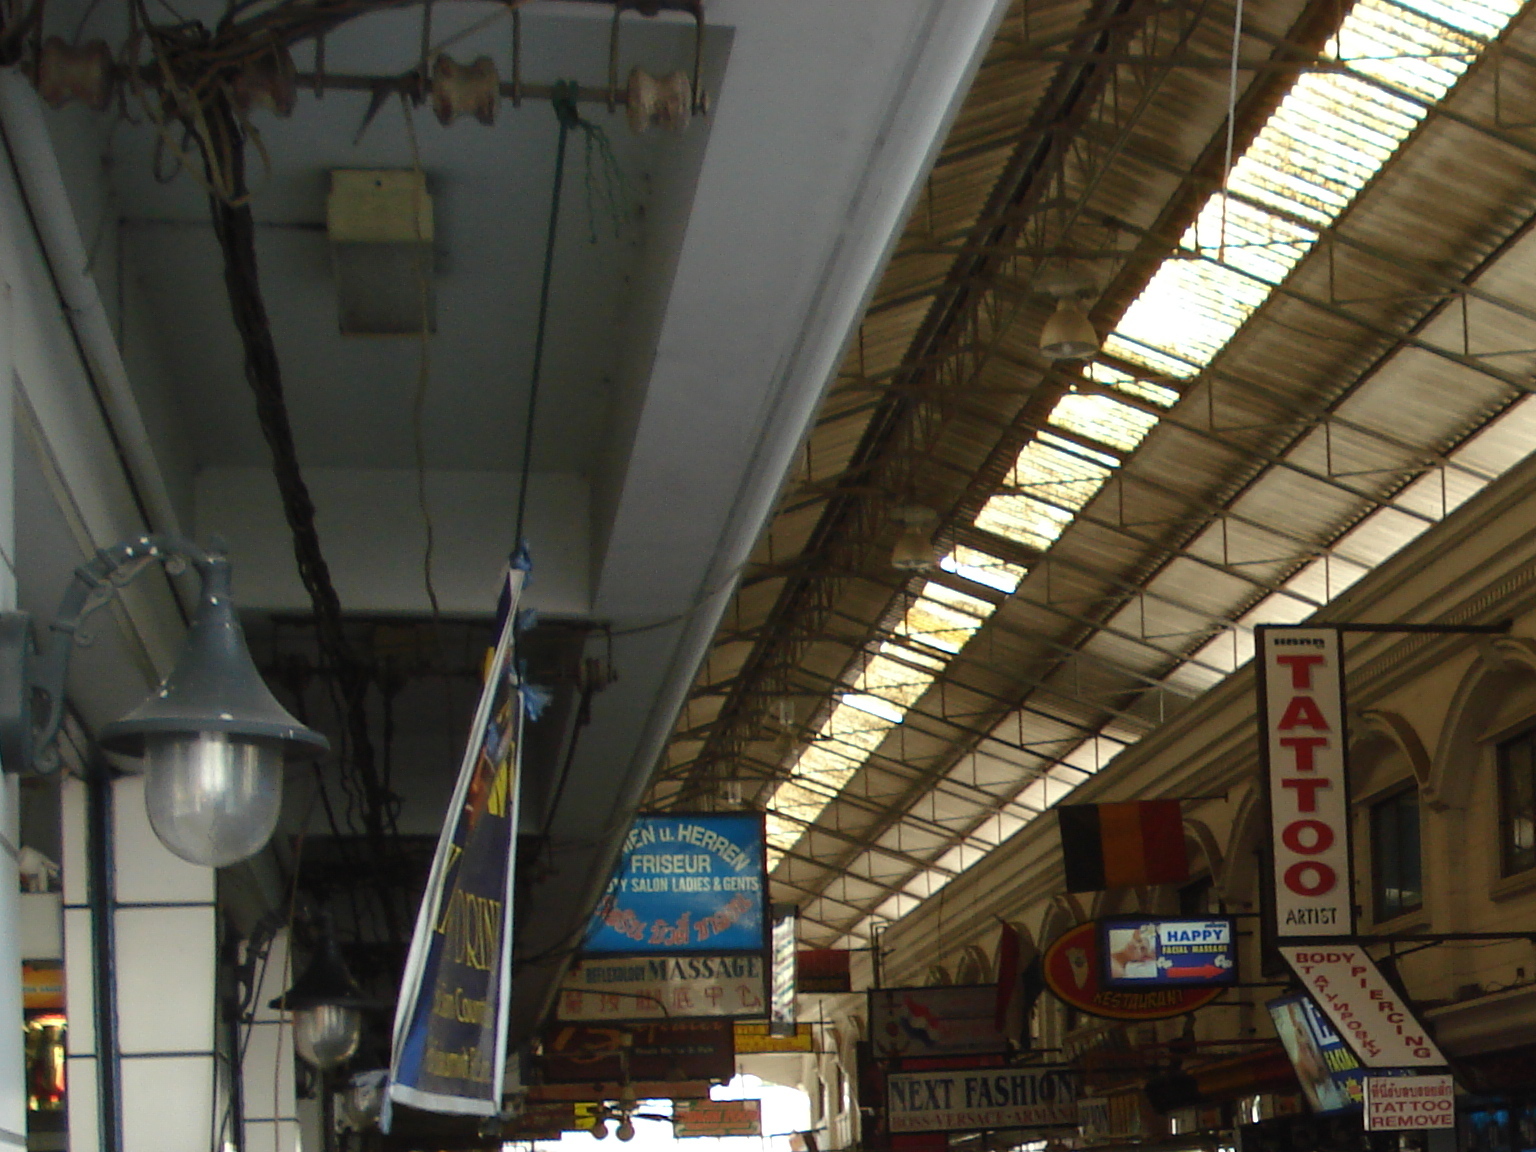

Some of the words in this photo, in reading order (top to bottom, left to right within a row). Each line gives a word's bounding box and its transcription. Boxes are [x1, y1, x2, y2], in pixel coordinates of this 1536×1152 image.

[1276, 655, 1336, 897] TATTOO
[677, 824, 751, 872] HERREN
[631, 854, 711, 874] FRISEUR
[631, 877, 668, 892] SALON
[672, 877, 710, 892] LADIES
[713, 876, 722, 891] &
[723, 875, 759, 891] GENTS
[1286, 907, 1337, 925] ARTIST
[1167, 930, 1223, 942] HAPPY
[1162, 946, 1188, 954] FACIAL
[1191, 945, 1228, 953] MASSAGE
[1296, 952, 1355, 964] BODY
[648, 957, 759, 981] MASSAGE
[1351, 966, 1431, 1059] PIERCING
[890, 1078, 955, 1112] NEXT
[964, 1074, 1077, 1109] FASHION
[1371, 1100, 1452, 1113] TATTOO
[1371, 1114, 1452, 1127] REMOVE
